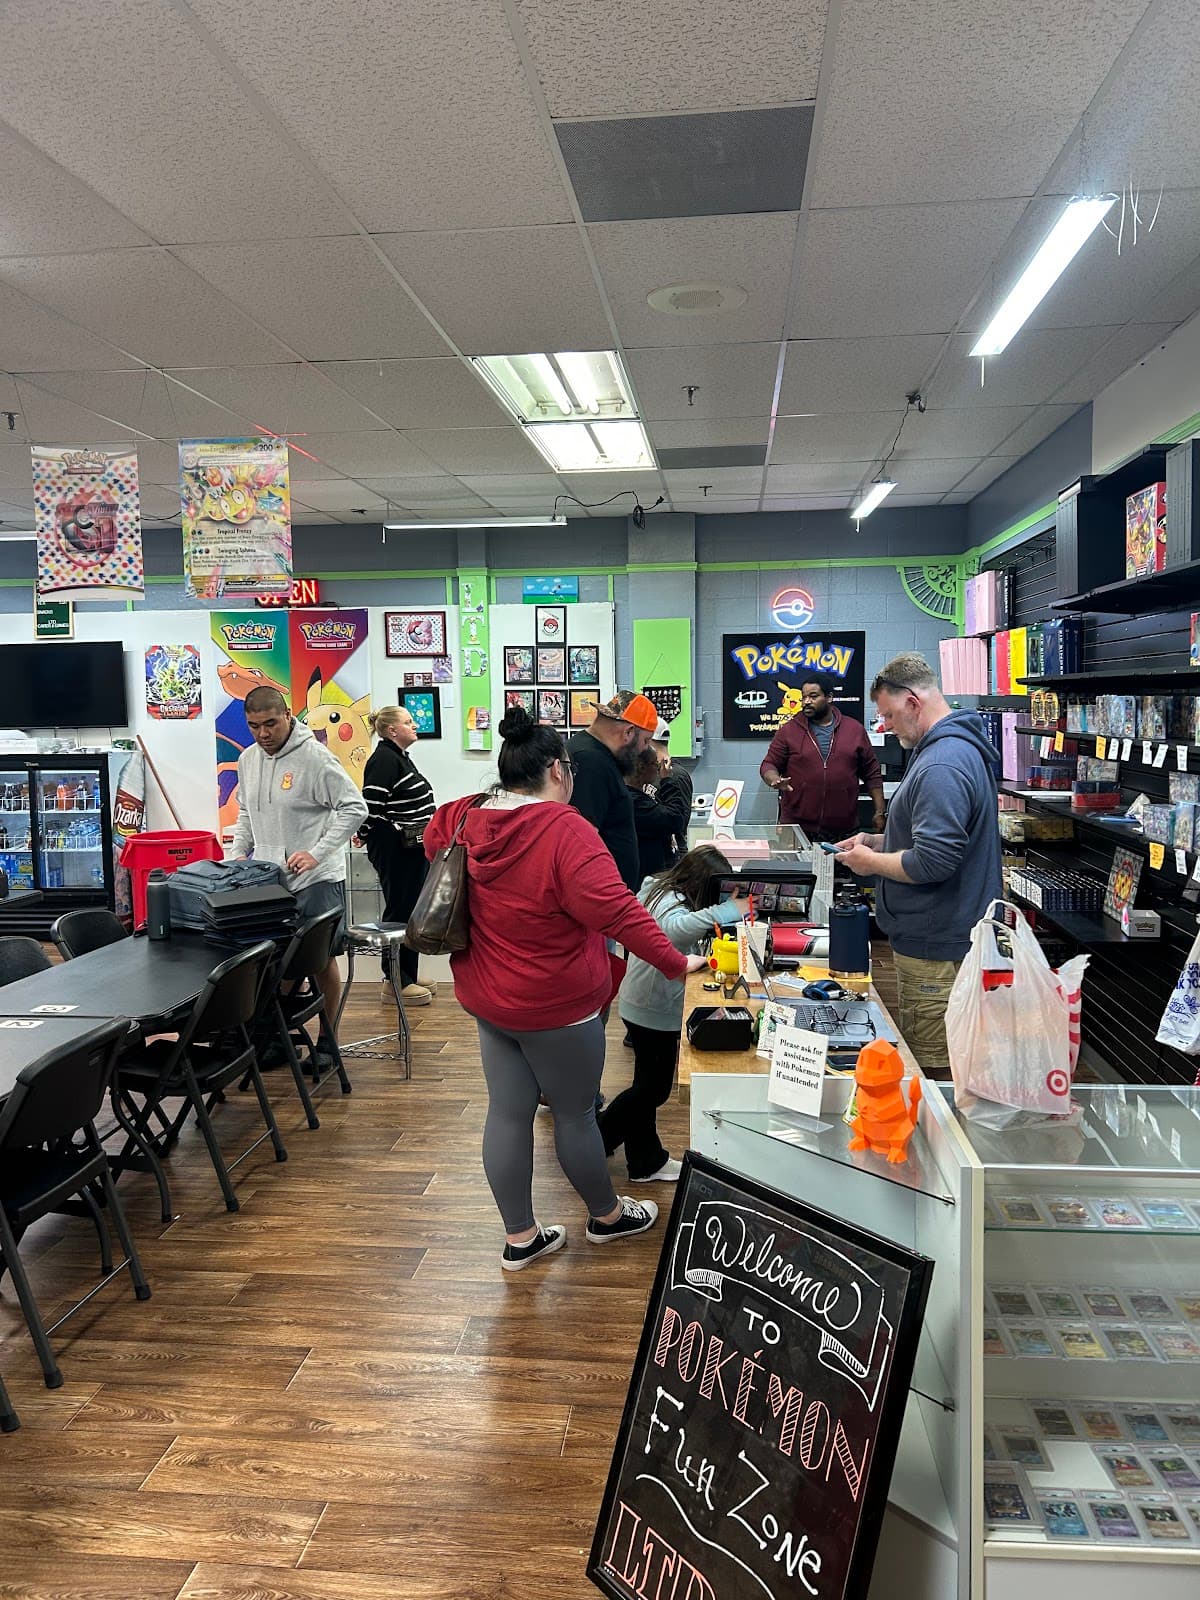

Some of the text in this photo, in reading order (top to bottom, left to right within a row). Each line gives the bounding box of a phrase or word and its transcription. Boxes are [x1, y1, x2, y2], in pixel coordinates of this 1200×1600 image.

[780, 1037, 823, 1056] Please ask for
[783, 1050, 817, 1065] assistance
[776, 1060, 821, 1078] with Pokemon
[776, 1070, 820, 1090] if unattended
[706, 1215, 862, 1331] Welcome
[743, 1306, 781, 1345] TO
[653, 1305, 870, 1503] POKÉMON
